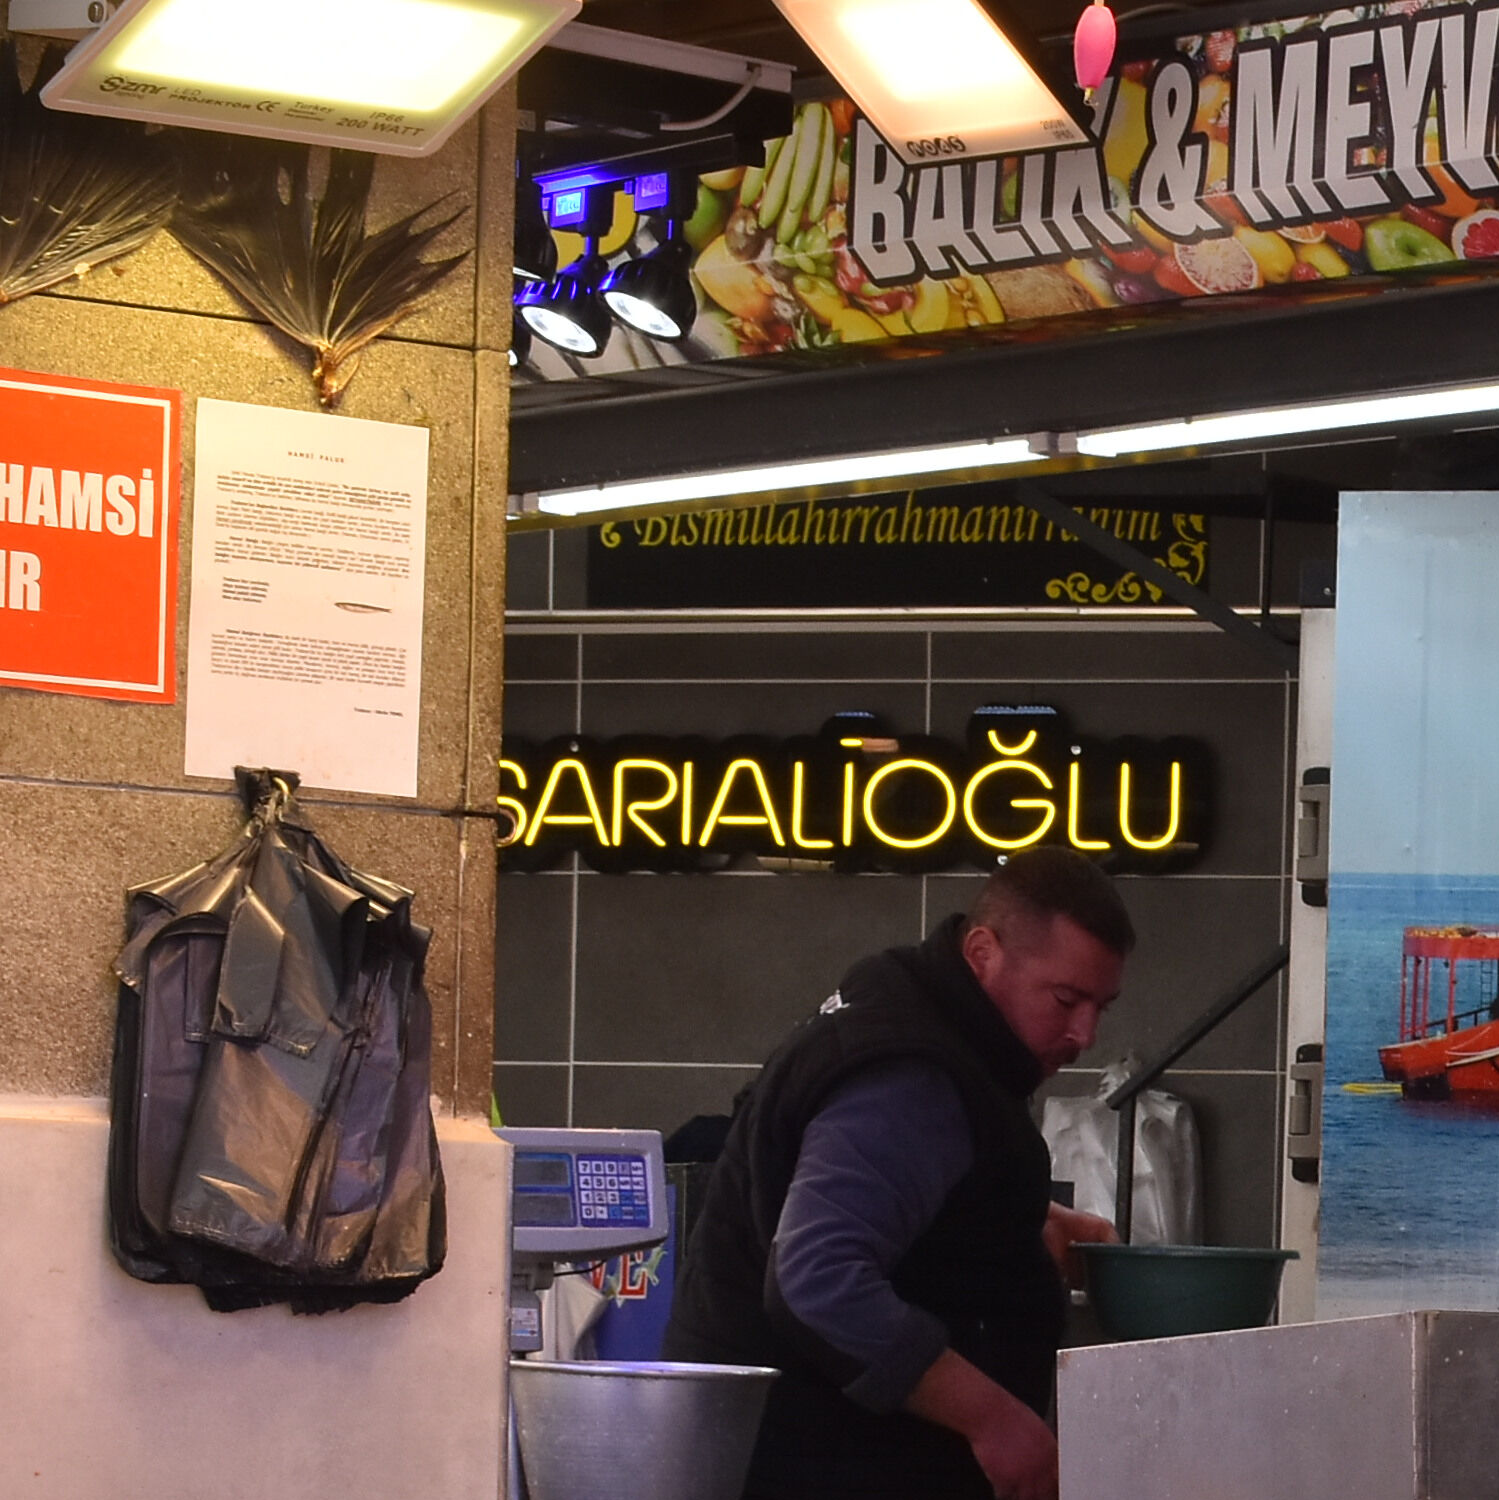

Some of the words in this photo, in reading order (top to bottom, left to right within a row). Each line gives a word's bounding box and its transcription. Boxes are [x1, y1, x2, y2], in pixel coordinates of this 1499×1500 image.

[336, 117, 369, 129] 200
[372, 122, 425, 136] WATT
[0, 462, 154, 538] HAMSİ
